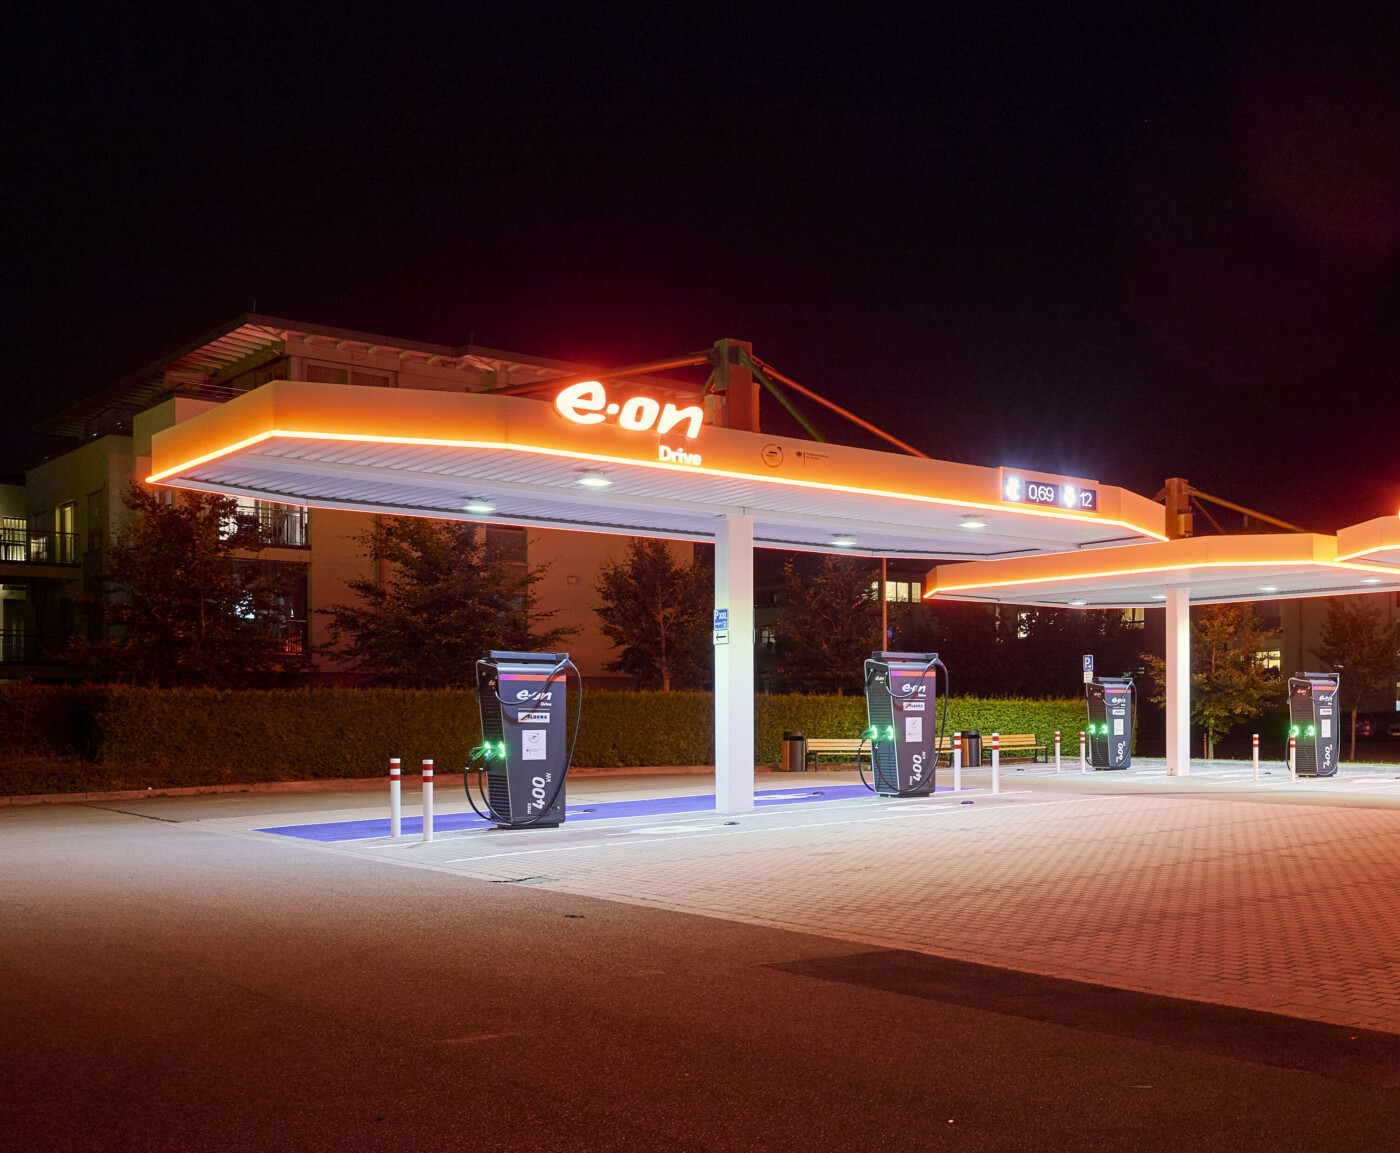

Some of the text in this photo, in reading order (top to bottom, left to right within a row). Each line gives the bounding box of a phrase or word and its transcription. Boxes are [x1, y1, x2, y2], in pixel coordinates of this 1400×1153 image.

[659, 446, 702, 465] Drive
[1028, 484, 1054, 502] 0,69
[1080, 492, 1092, 507] 12
[1085, 657, 1090, 668] P
[913, 755, 922, 781] 400
[532, 777, 546, 809] 400
